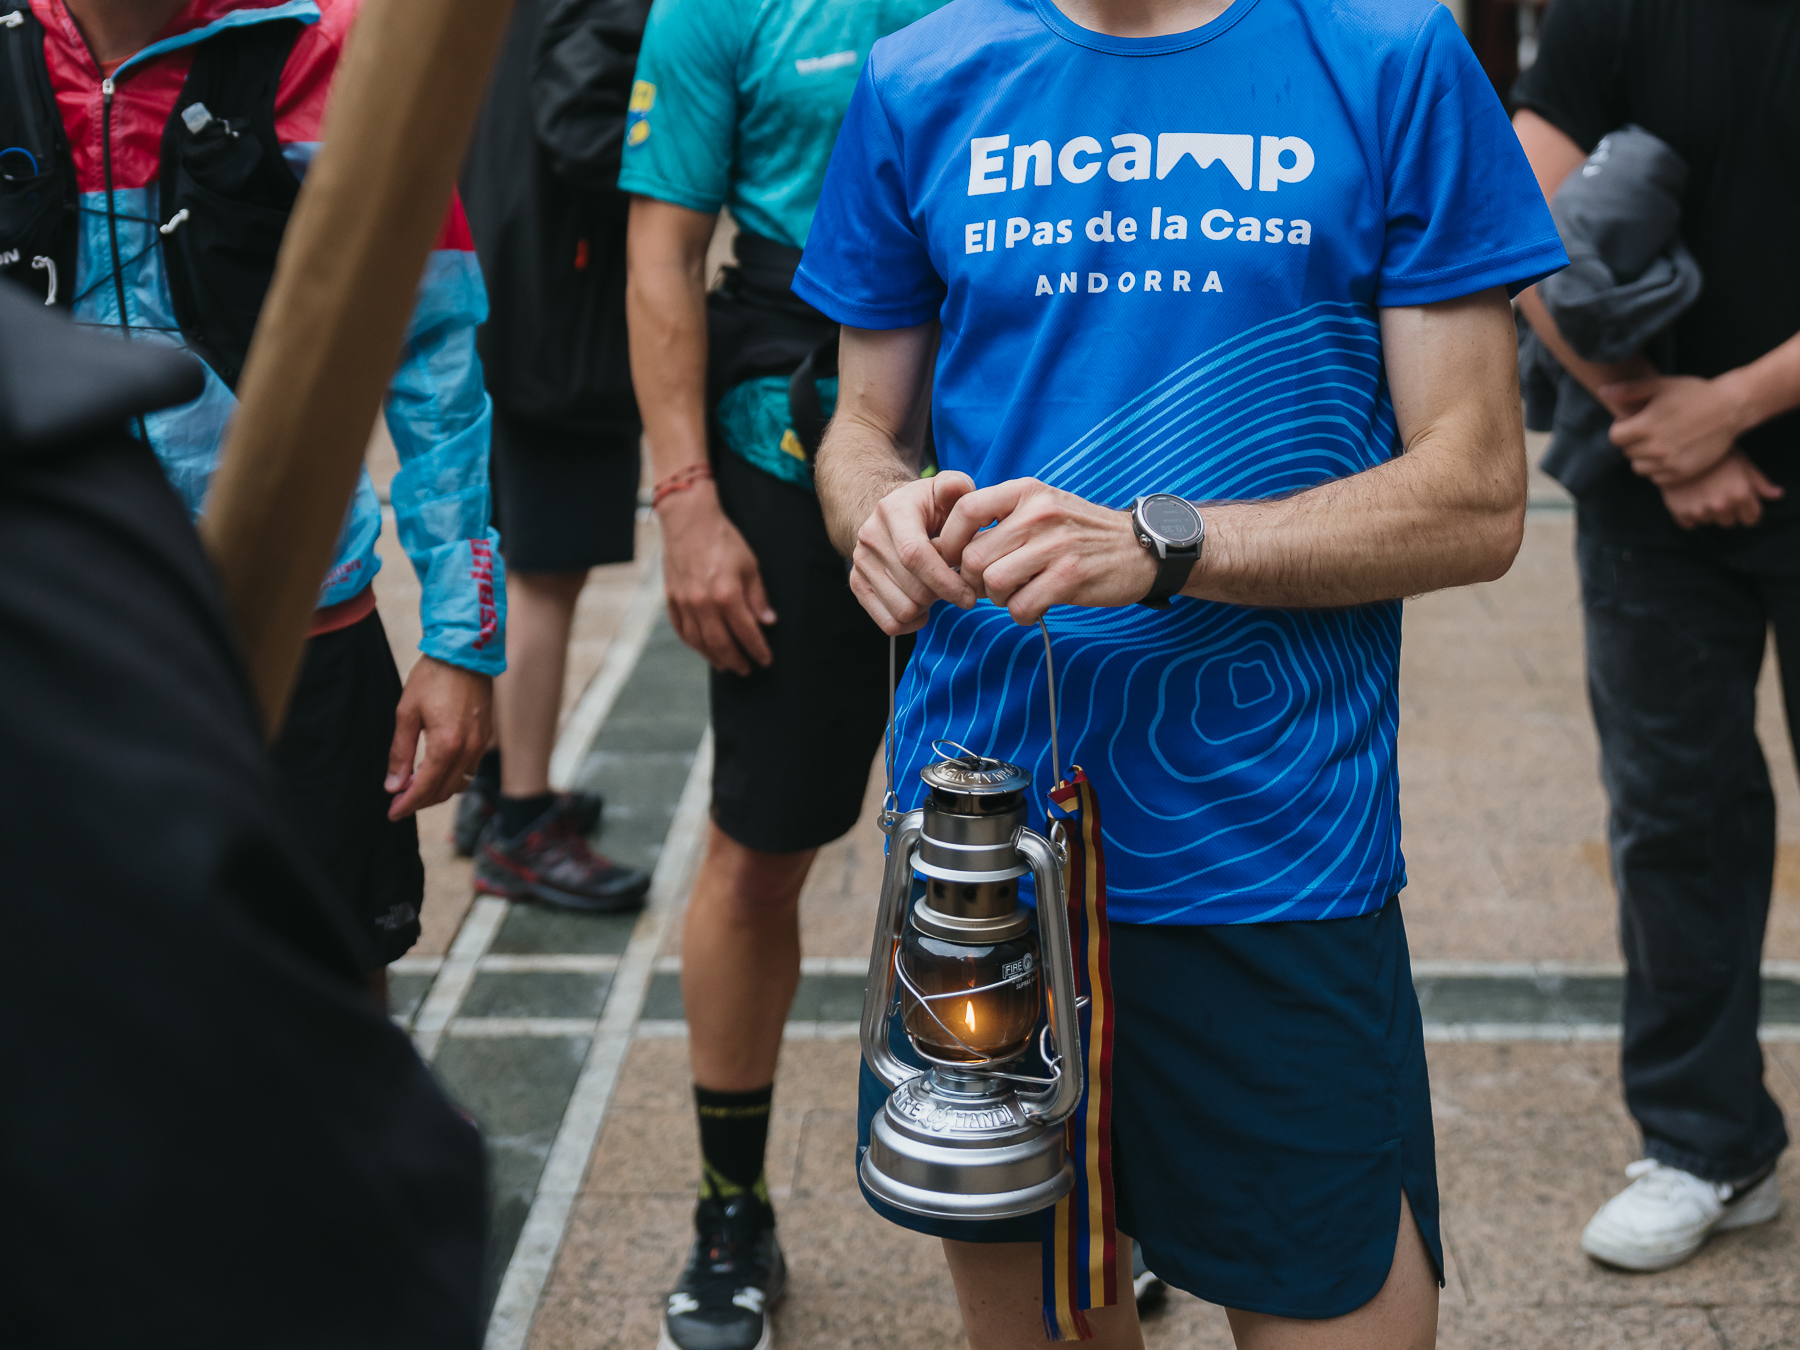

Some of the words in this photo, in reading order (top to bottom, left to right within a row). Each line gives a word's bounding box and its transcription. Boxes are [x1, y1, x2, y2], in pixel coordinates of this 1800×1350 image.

[967, 132, 1315, 197] Encamp
[965, 219, 996, 255] El
[1005, 216, 1073, 249] Pas
[1085, 210, 1138, 243] de
[1150, 206, 1188, 240] la
[1200, 208, 1312, 245] Casa
[1035, 270, 1224, 297] ANDORRA
[1005, 961, 1023, 974] FIRE
